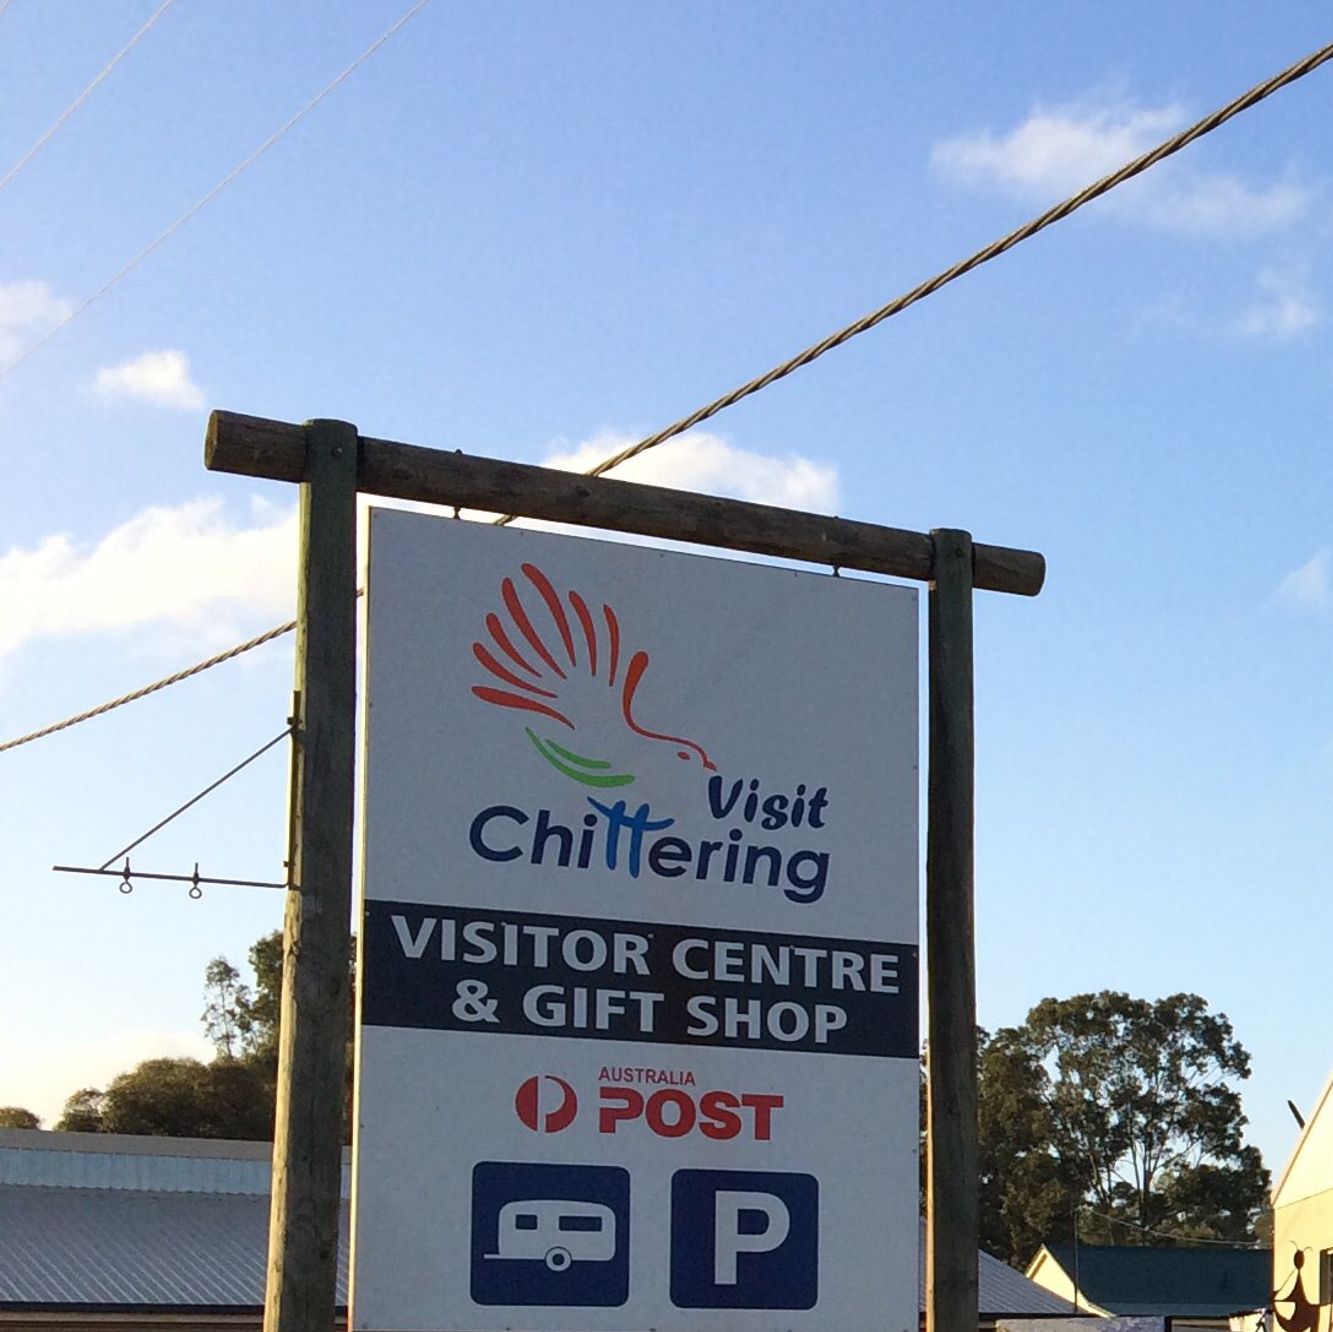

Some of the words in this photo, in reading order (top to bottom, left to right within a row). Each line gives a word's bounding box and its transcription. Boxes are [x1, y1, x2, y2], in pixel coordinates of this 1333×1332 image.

[708, 775, 829, 831] Visit
[469, 796, 831, 905] Chittering
[391, 914, 652, 976] VISITOR
[672, 938, 900, 995] CENTRE
[451, 979, 501, 1024] &
[522, 985, 665, 1033] GIFT
[687, 995, 848, 1044] SHOP
[598, 1066, 696, 1087] AUSTRALIA
[599, 1087, 784, 1141] POST
[714, 1190, 790, 1286] P
